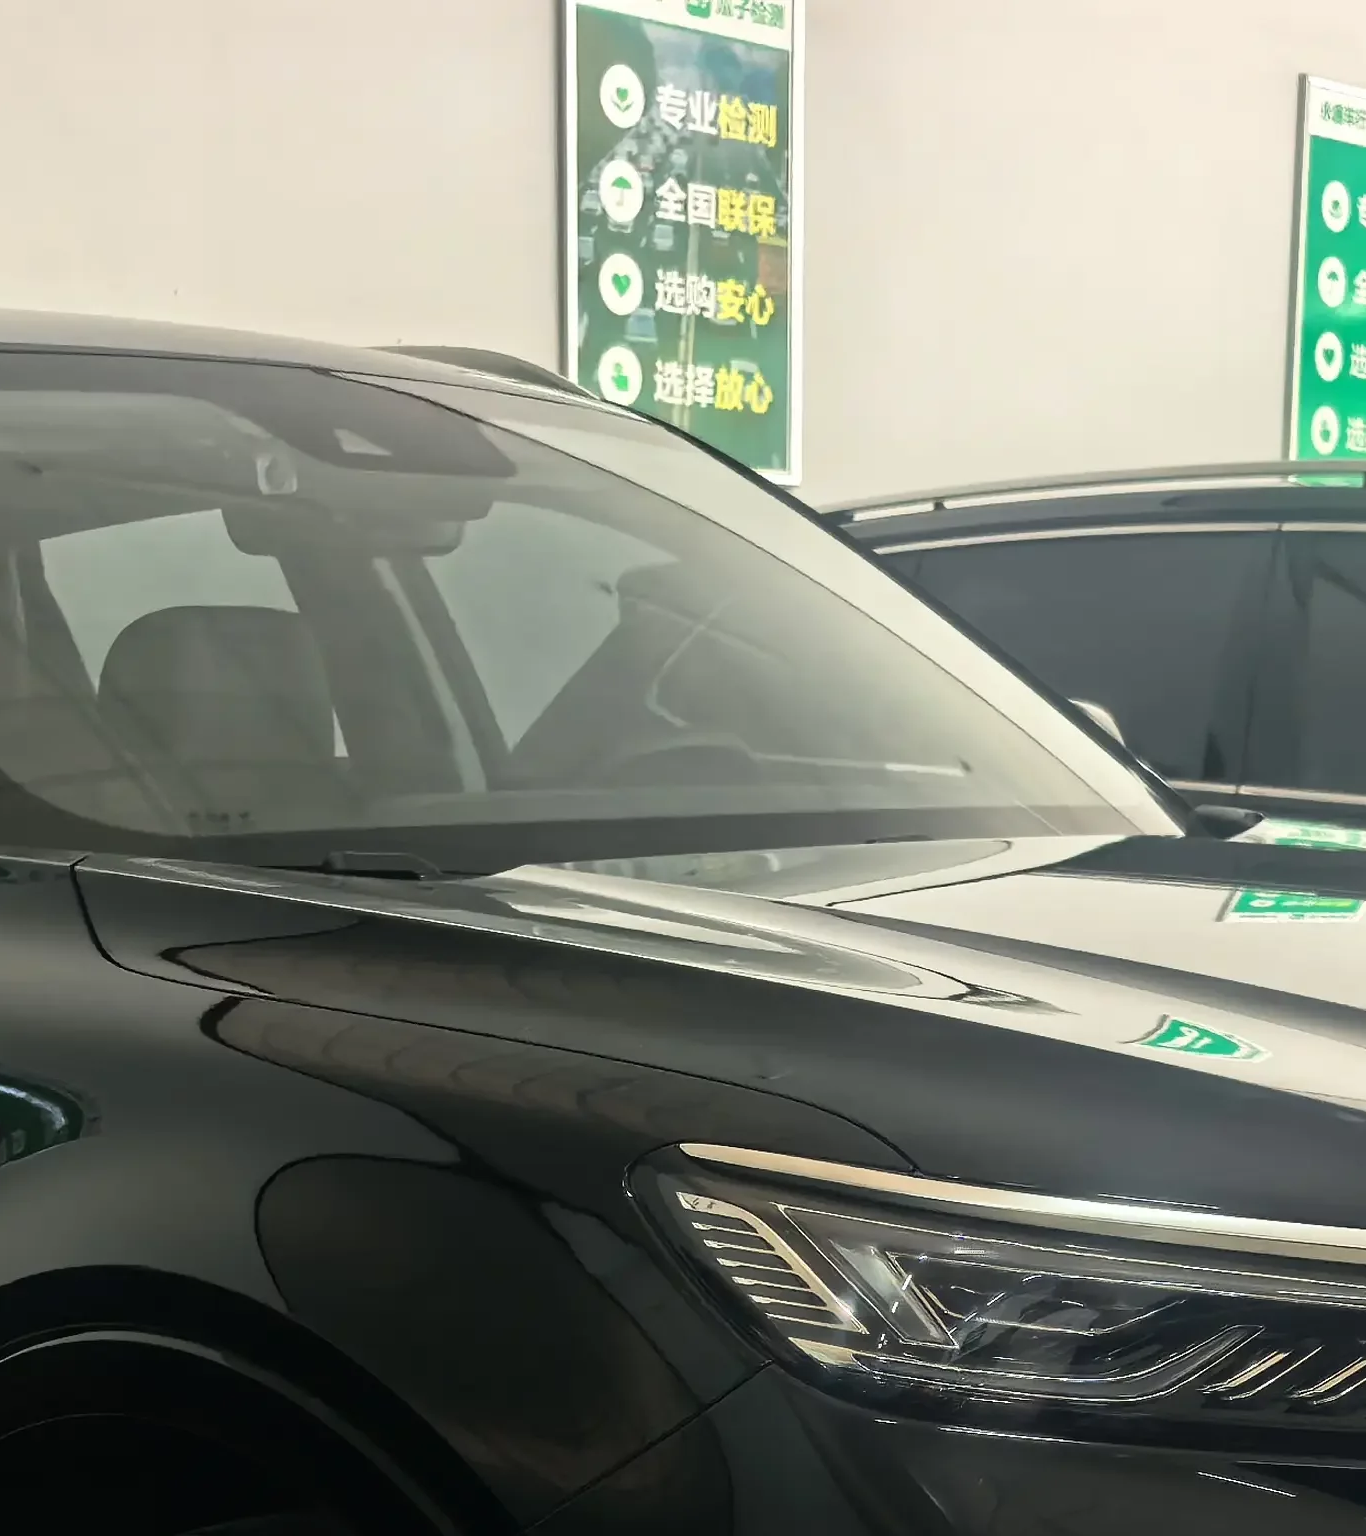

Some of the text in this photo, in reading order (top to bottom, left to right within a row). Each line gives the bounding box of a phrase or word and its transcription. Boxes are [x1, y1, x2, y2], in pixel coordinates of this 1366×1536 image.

[655, 83, 778, 148] 专业检测
[655, 176, 777, 240] 全国联保
[654, 267, 775, 326] 选购安心
[653, 357, 774, 415] 选择放心
